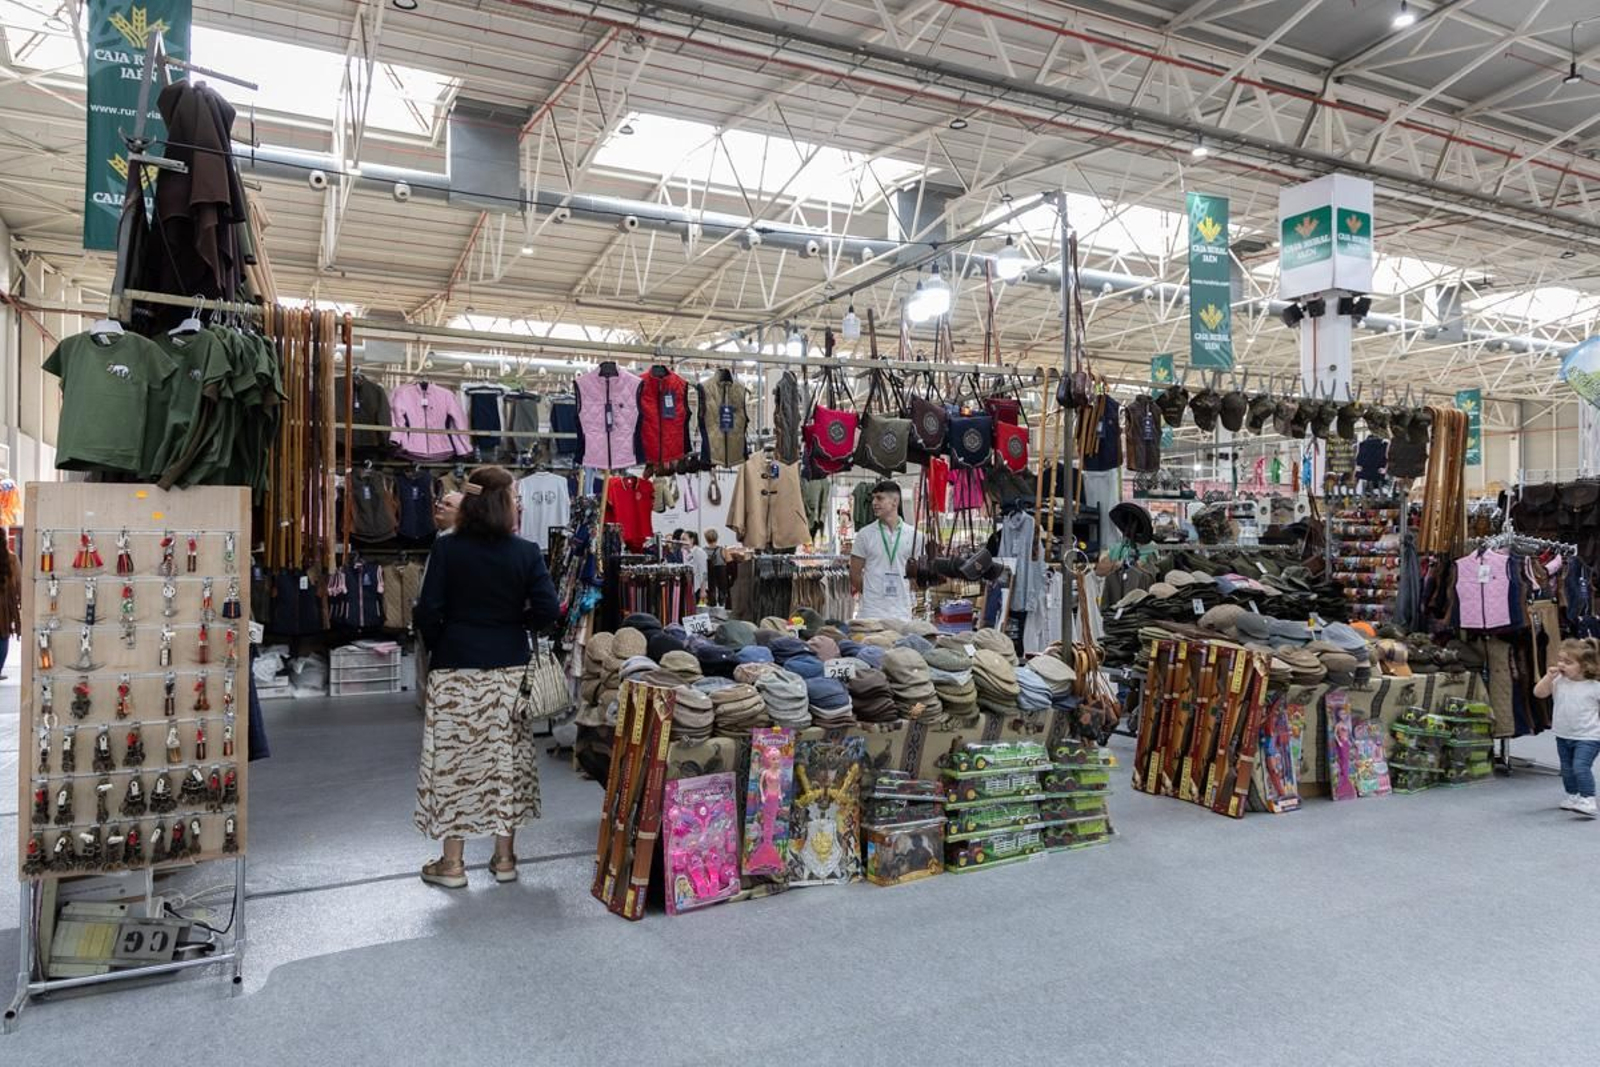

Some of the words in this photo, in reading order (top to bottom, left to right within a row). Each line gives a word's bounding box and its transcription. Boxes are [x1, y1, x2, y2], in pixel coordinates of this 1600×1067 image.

[94, 49, 130, 64] CAJA
[830, 667, 850, 681] 25€
[123, 930, 169, 953] CG
